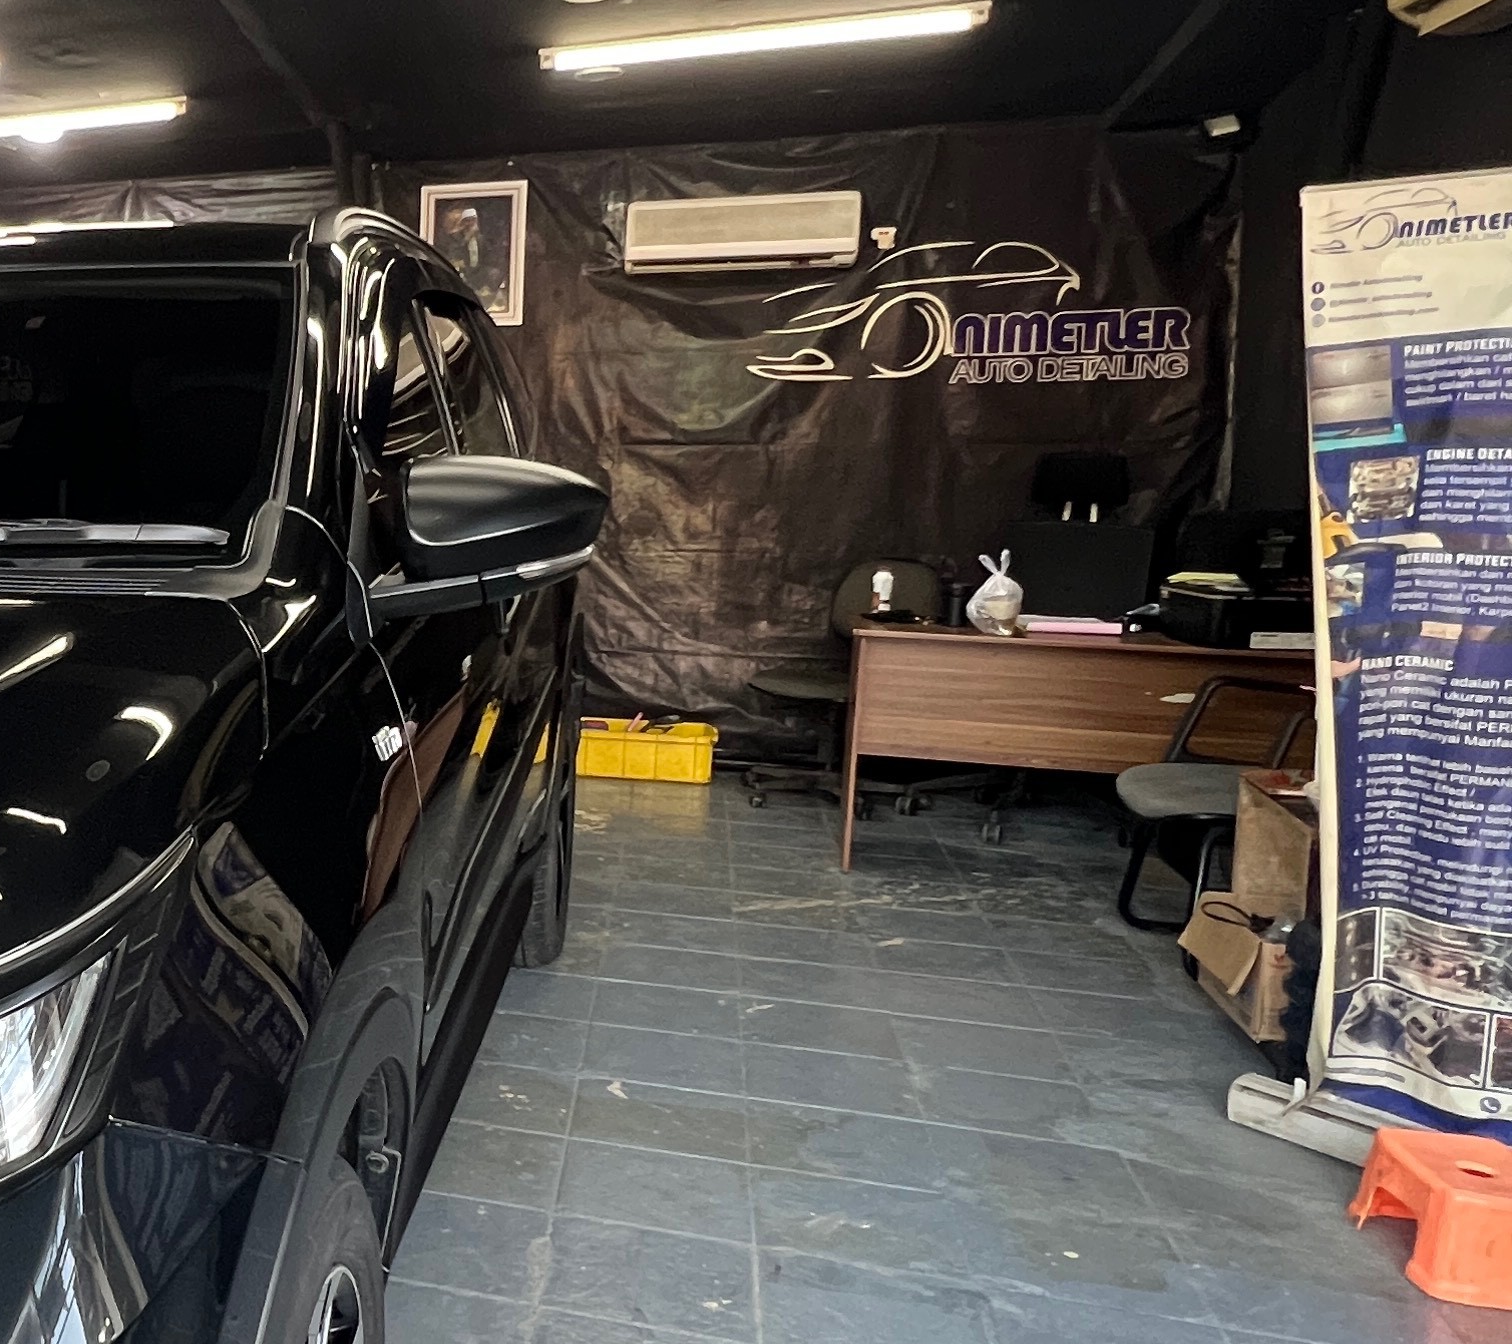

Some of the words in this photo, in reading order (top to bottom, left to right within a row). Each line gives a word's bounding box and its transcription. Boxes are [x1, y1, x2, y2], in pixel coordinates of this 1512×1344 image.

[1445, 337, 1512, 352] PROTECTI
[948, 357, 1034, 385] AUTO
[1037, 353, 1190, 383] DETAILING
[1395, 655, 1454, 671] CERAMIC
[1476, 721, 1512, 734] PER
